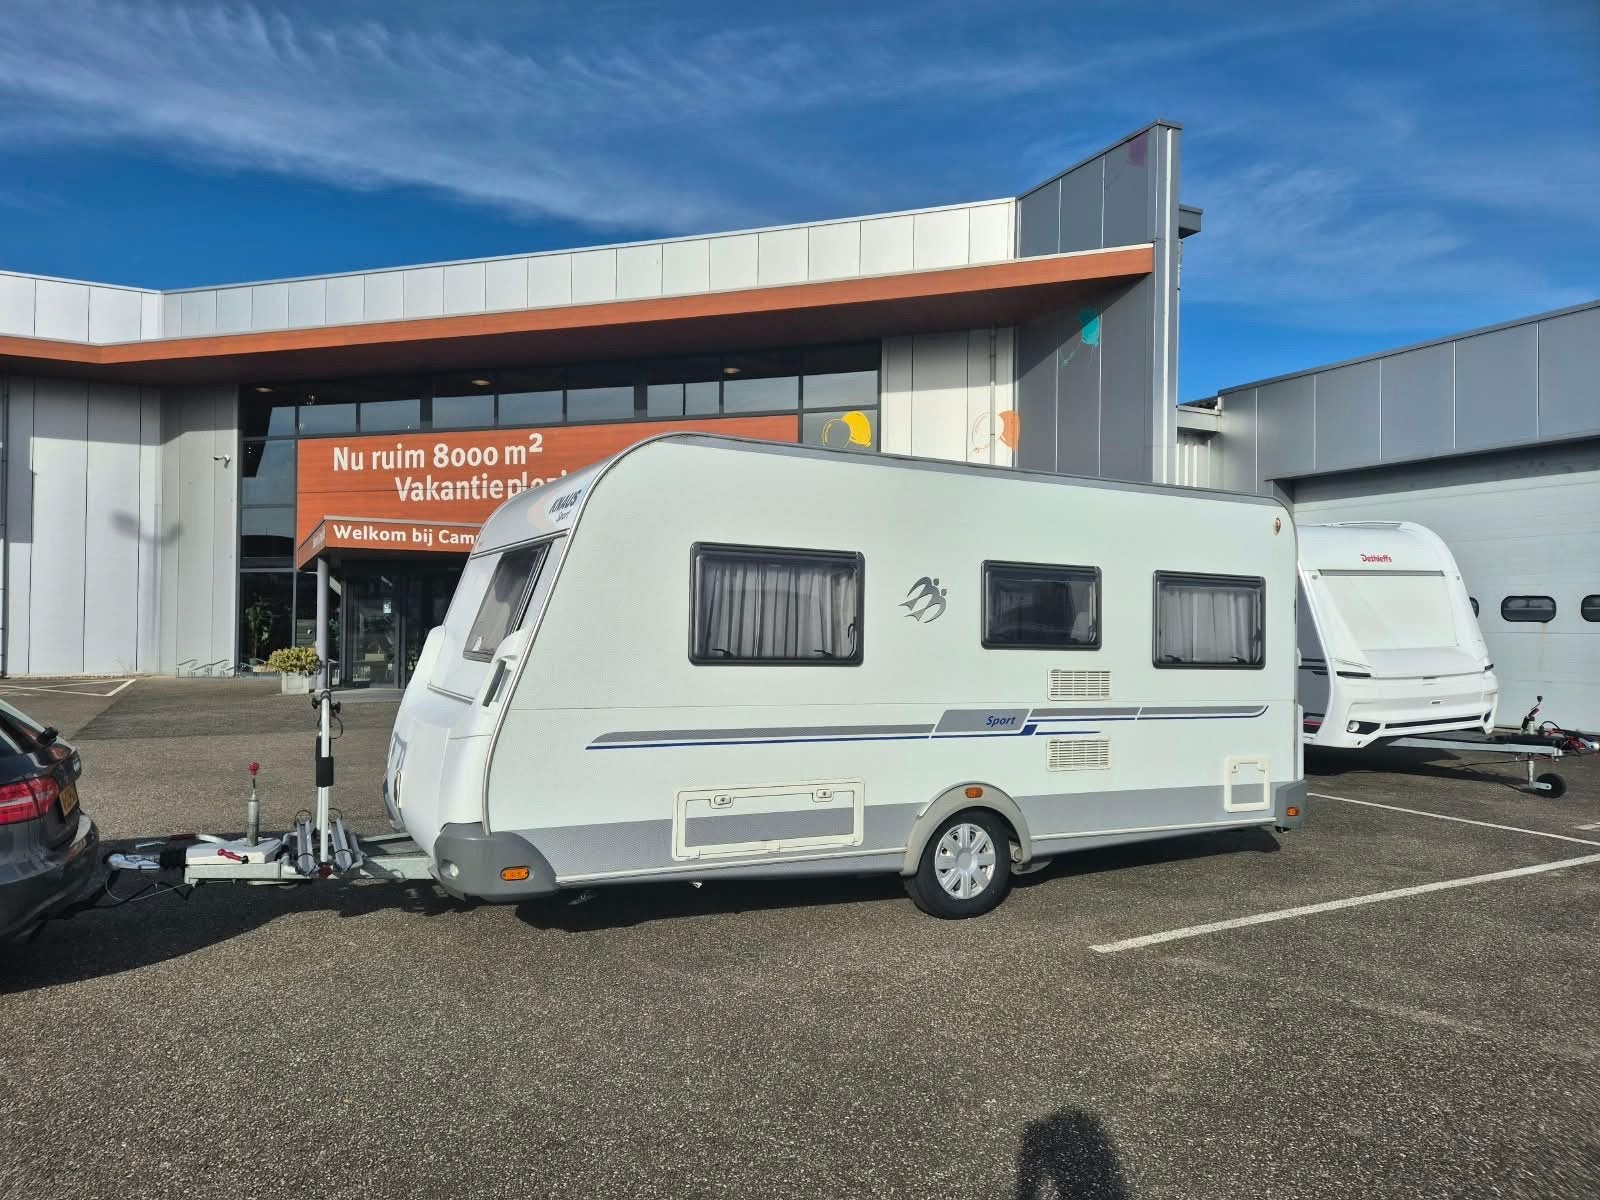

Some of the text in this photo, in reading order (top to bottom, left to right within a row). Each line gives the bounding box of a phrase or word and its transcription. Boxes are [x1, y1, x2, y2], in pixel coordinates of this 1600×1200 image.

[333, 446, 364, 471] Nu
[372, 442, 425, 470] ruim
[433, 442, 499, 468] 8000
[333, 524, 407, 543] Welkom
[412, 527, 433, 547] bij
[1360, 554, 1392, 562] Dethleffs
[986, 716, 1016, 727] Sport
